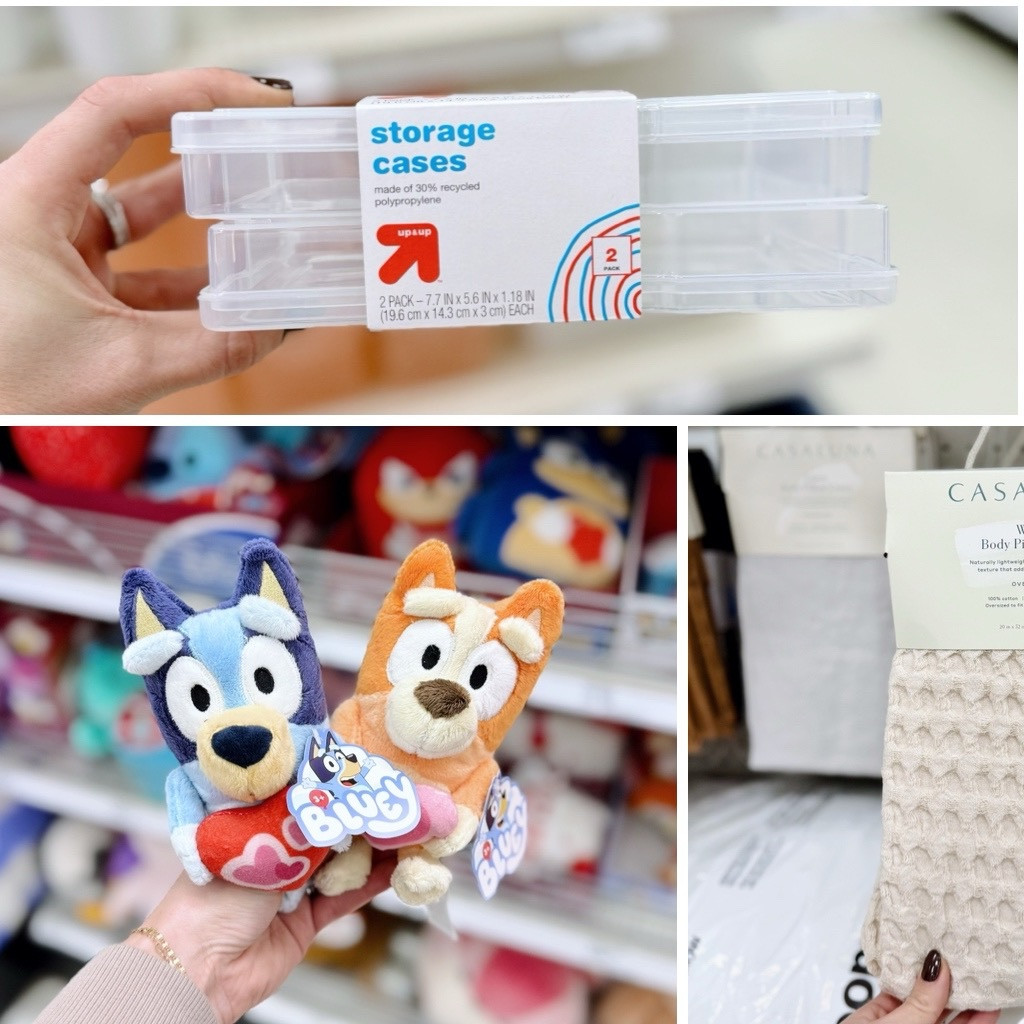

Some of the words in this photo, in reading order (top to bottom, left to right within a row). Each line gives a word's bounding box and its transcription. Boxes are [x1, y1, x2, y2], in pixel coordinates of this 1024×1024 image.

[370, 121, 496, 147] storage
[372, 153, 467, 175] cases
[374, 185, 401, 194] made
[403, 184, 413, 193] of
[415, 183, 437, 193] 30%
[440, 181, 480, 193] recycled
[374, 195, 442, 208] polypropylene
[605, 248, 618, 263] 2
[379, 295, 386, 308] 2
[388, 294, 415, 308] PACK
[425, 292, 441, 306] 7.7
[443, 292, 454, 305] IN
[455, 295, 462, 304] x
[463, 291, 479, 305] 5.6
[481, 291, 492, 303] IN
[493, 293, 499, 302] x
[502, 290, 523, 303] 1.18
[525, 290, 535, 302] IN
[380, 308, 404, 322] (19.6
[407, 310, 422, 319] cm
[424, 310, 430, 319] x
[433, 306, 454, 320] 14.3
[456, 308, 471, 318] cm
[472, 308, 479, 317] x
[480, 305, 487, 317] 3
[489, 304, 507, 318] cm)
[508, 304, 535, 316] EACH
[981, 538, 1011, 551] Body
[312, 794, 325, 802] 3+
[300, 773, 418, 843] BLUEY
